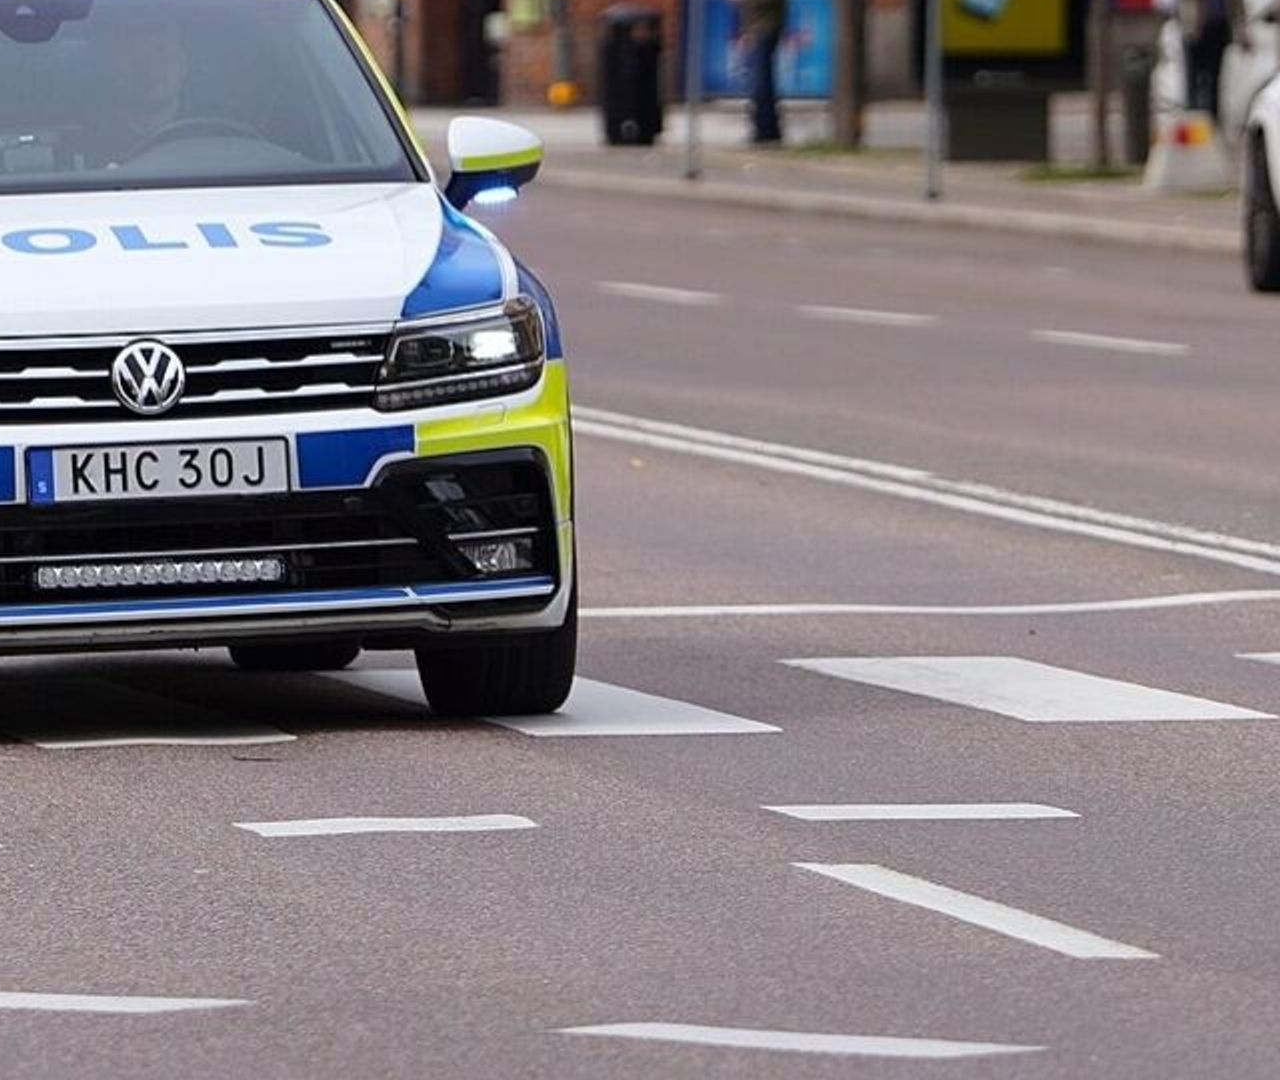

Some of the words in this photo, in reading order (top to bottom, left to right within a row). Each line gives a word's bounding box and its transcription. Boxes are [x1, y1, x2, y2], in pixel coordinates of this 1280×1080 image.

[71, 451, 160, 495] KHC
[178, 446, 265, 489] 30J
[37, 480, 48, 494] S
